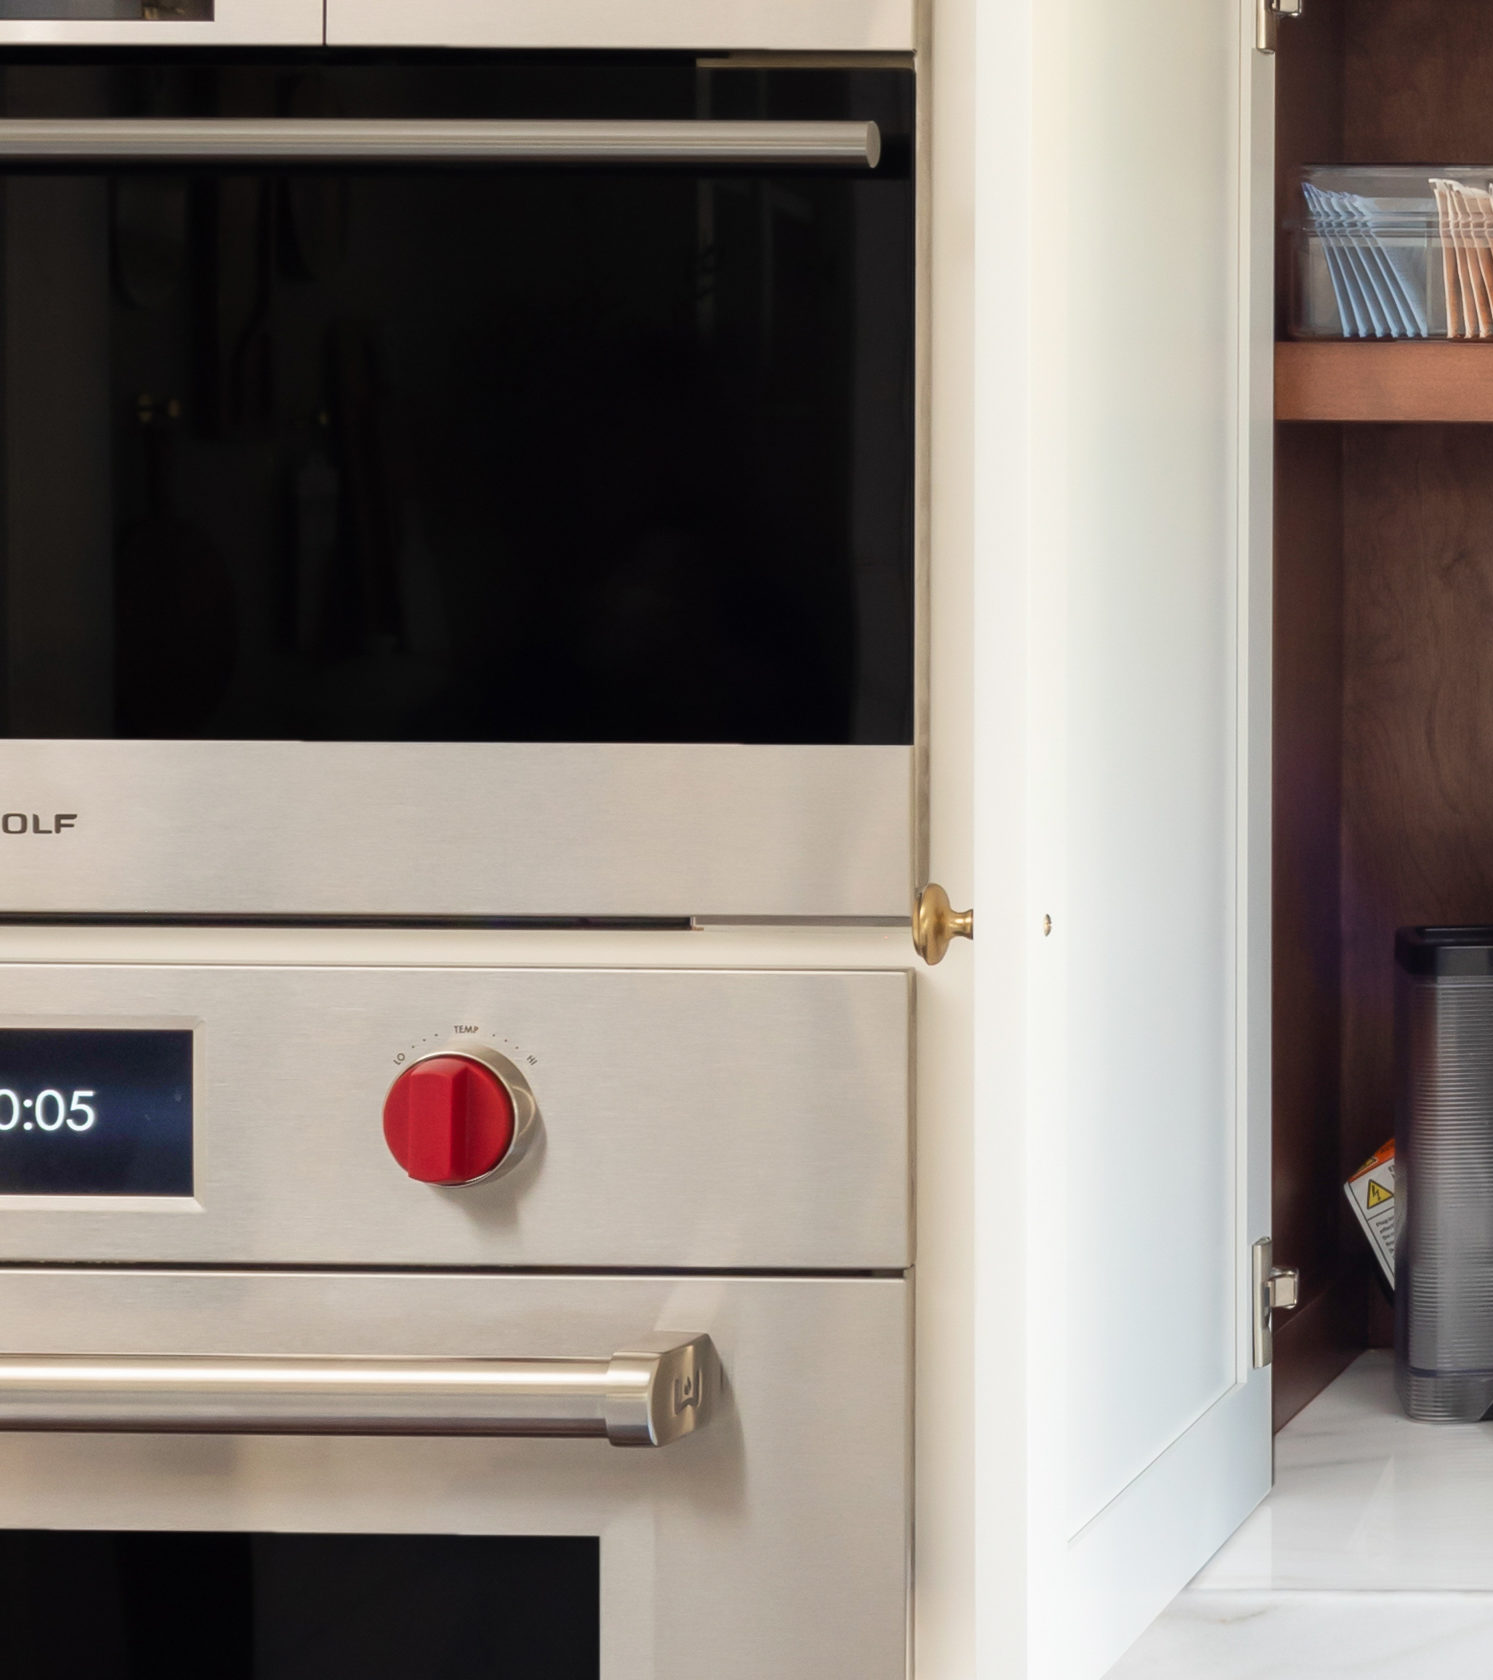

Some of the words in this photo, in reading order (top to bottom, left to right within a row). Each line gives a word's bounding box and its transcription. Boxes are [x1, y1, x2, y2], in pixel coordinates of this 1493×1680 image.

[2, 812, 78, 834] OLF
[454, 1025, 479, 1034] TEMP
[393, 1052, 405, 1066] LO
[526, 1054, 538, 1066] HI
[0, 1089, 96, 1131] 0:05
